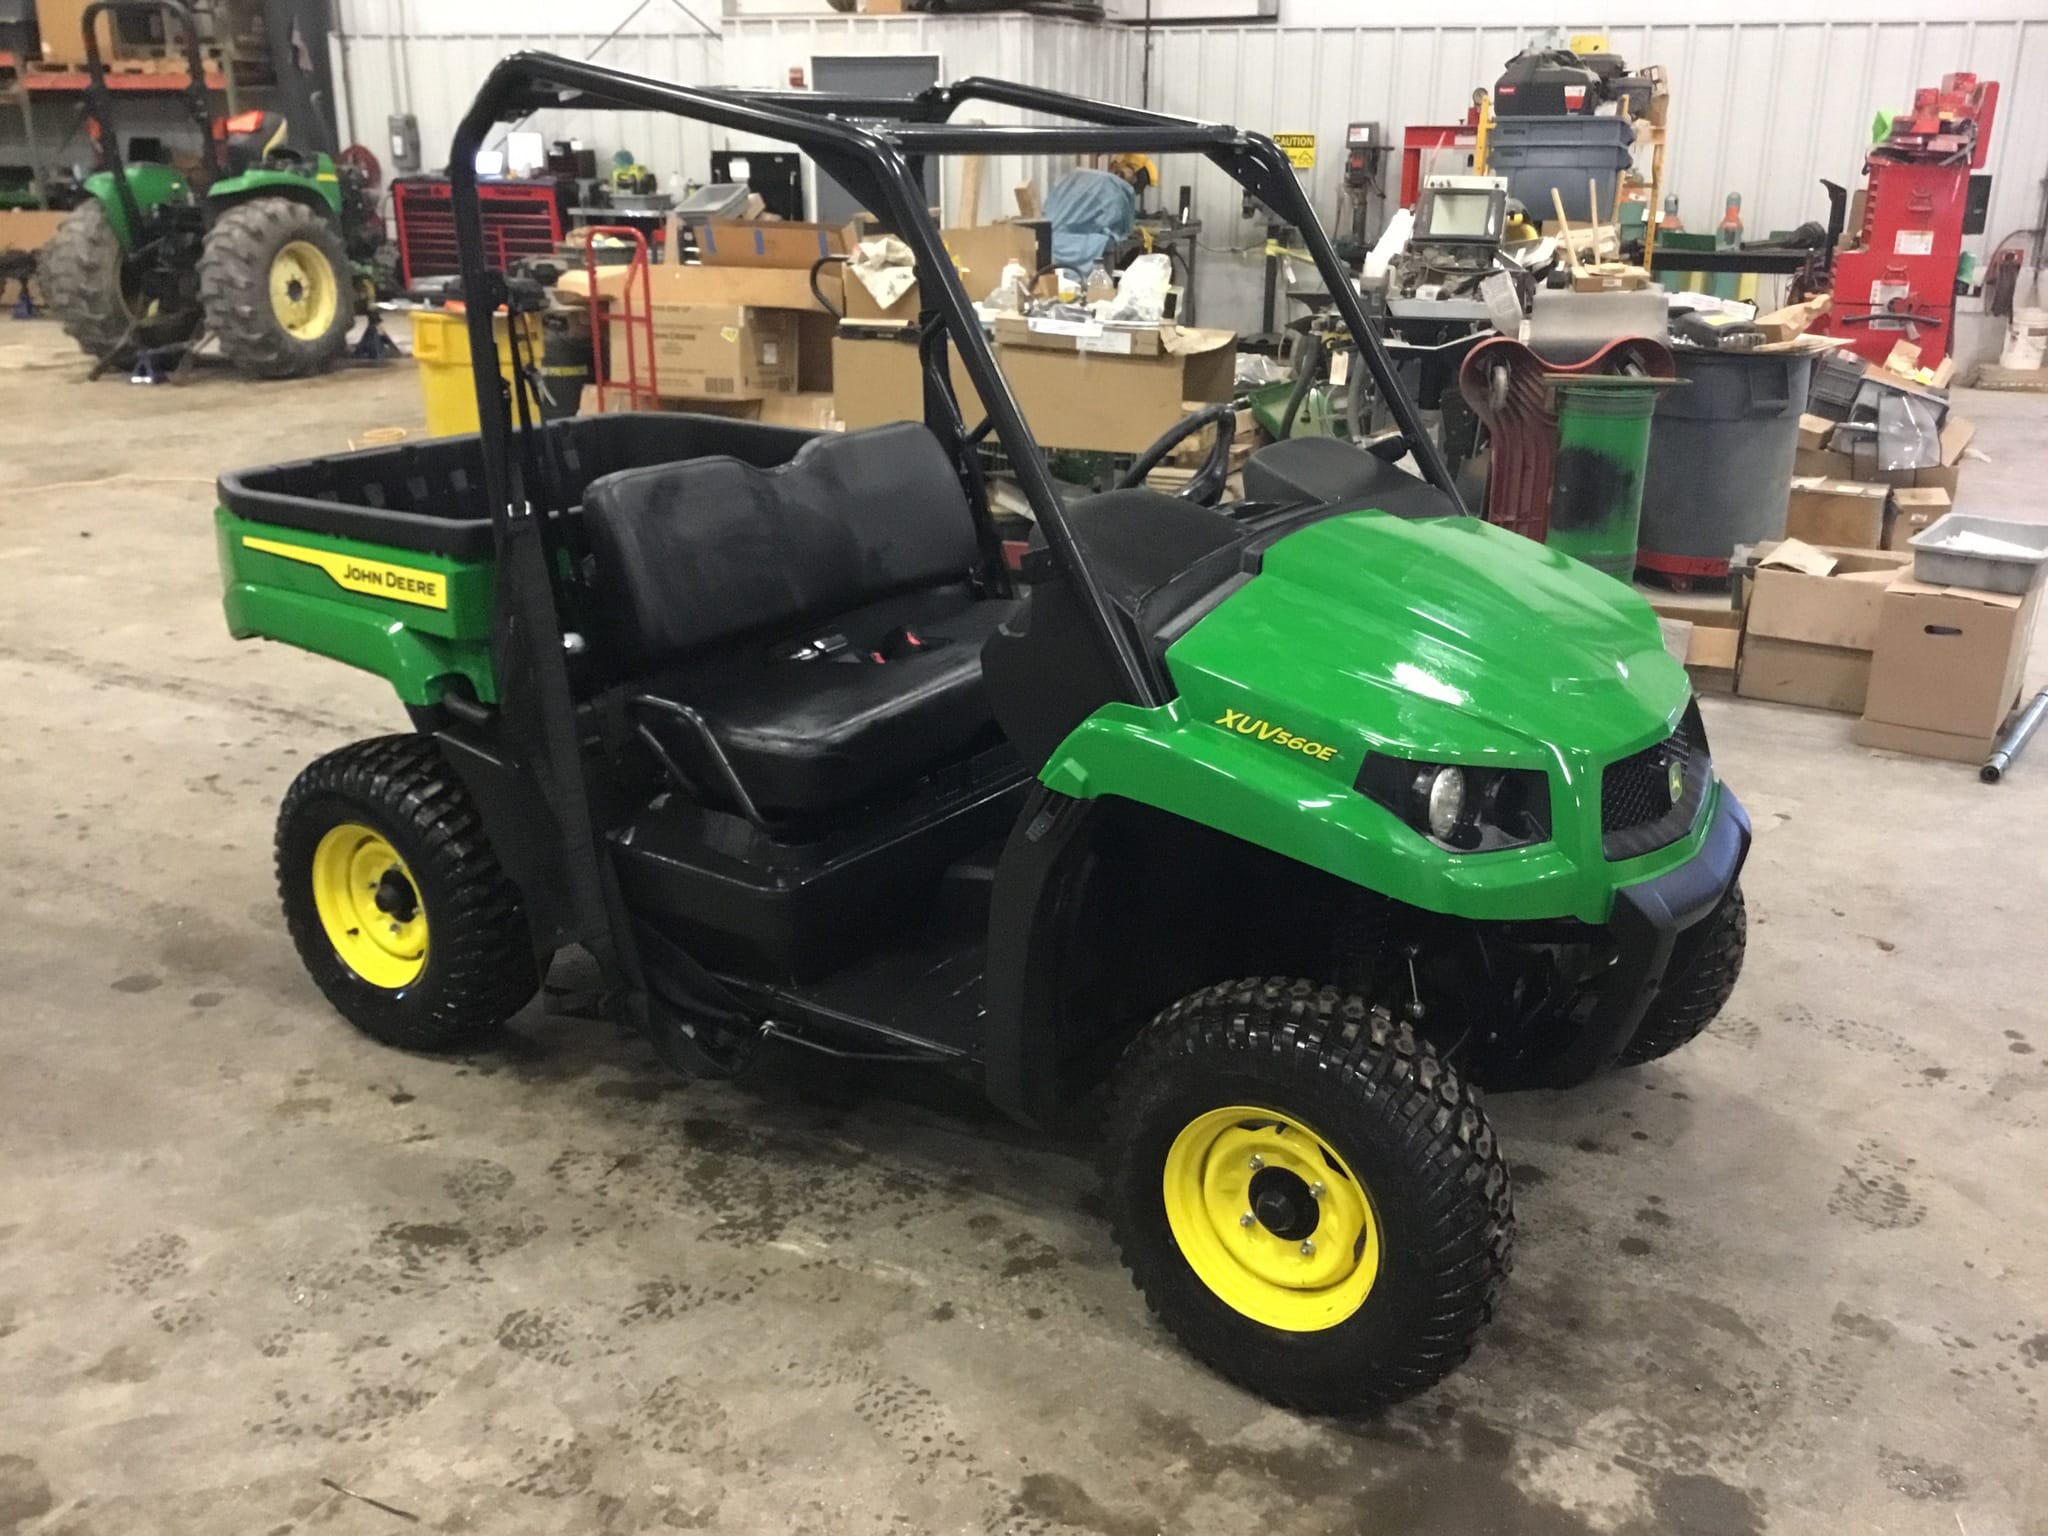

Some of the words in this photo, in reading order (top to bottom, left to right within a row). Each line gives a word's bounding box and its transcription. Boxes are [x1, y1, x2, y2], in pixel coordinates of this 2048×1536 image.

[1274, 136, 1314, 147] CAUTION
[343, 563, 383, 585] JOHN
[386, 571, 437, 597] DEERE
[1214, 708, 1338, 762] XUV560E
